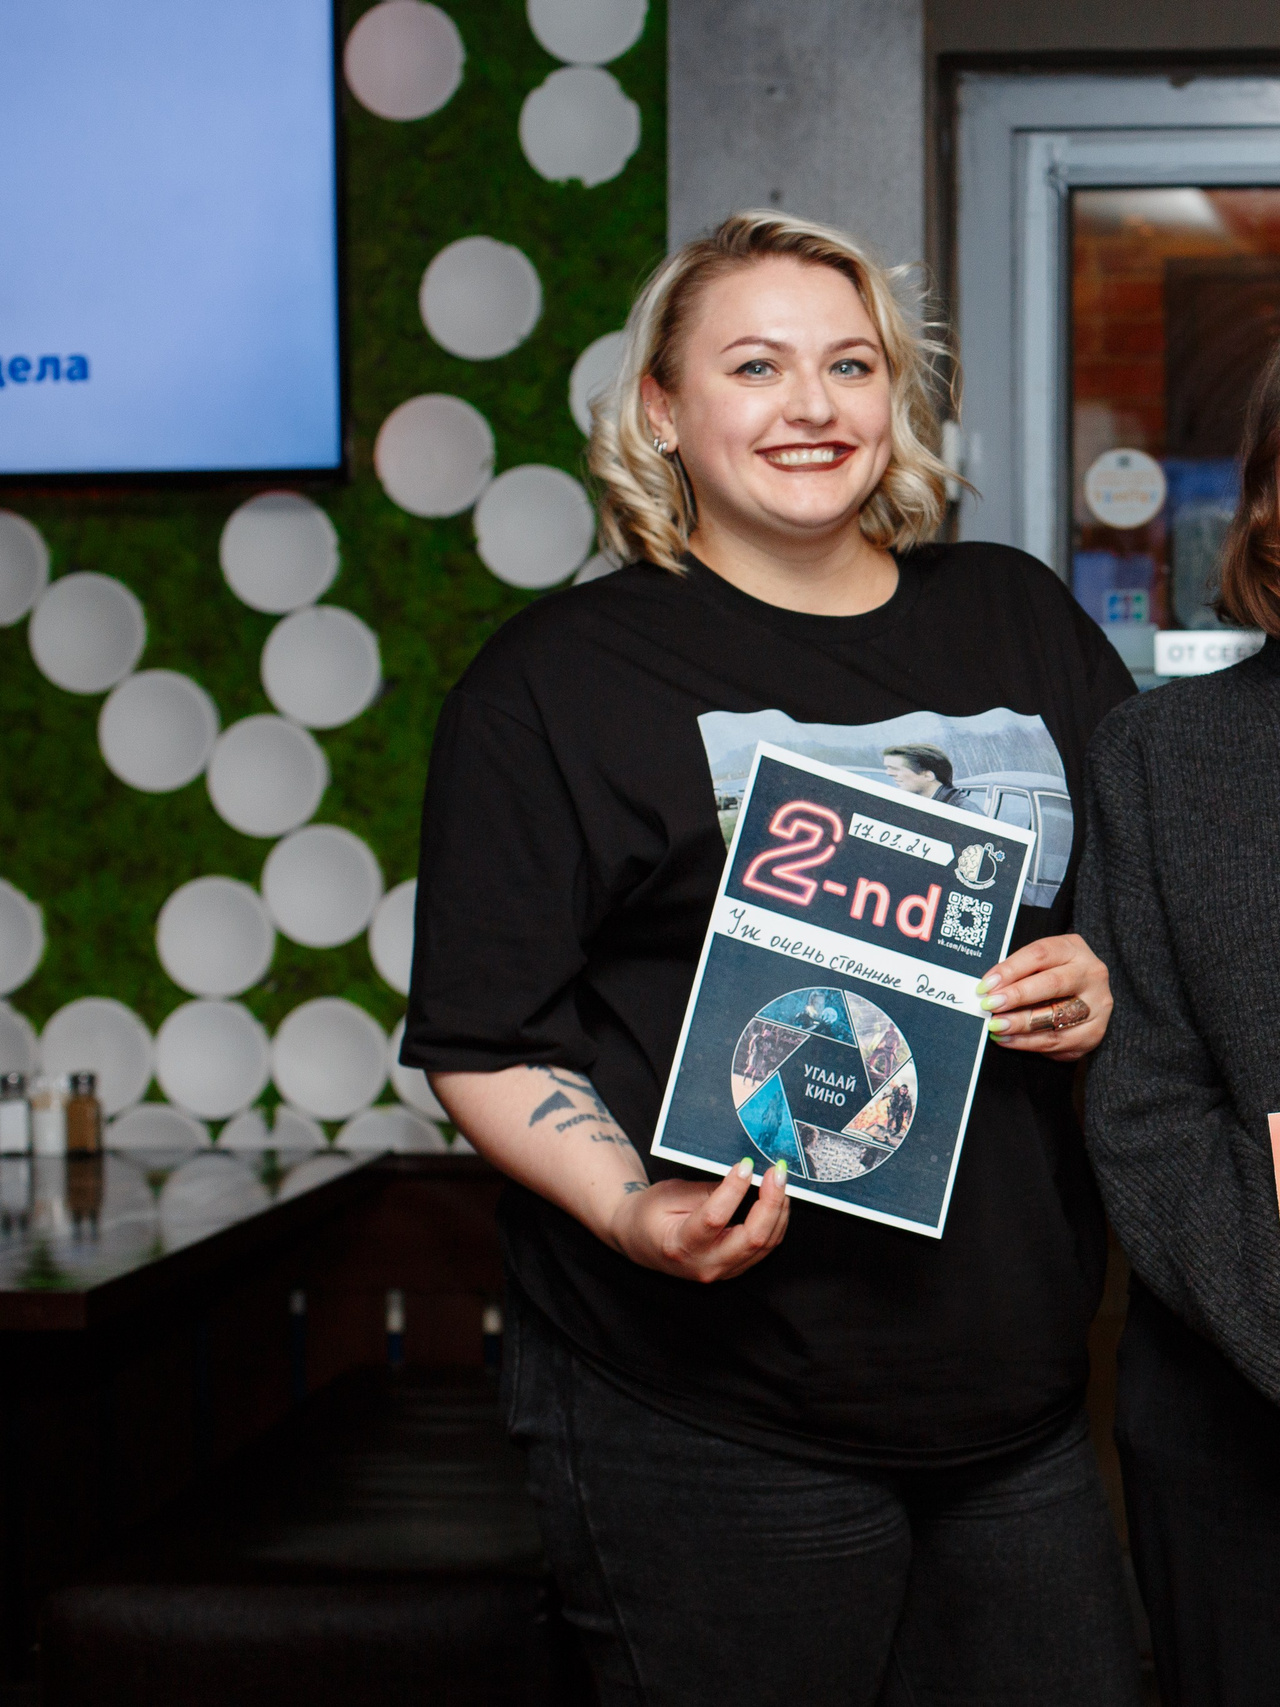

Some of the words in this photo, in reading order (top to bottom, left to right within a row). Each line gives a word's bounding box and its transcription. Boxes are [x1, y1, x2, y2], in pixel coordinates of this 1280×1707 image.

[0, 355, 89, 388] ела
[743, 799, 943, 943] 2-nd
[729, 907, 762, 941] Уж
[770, 935, 825, 964] очень
[916, 973, 964, 1004] дела
[937, 938, 983, 958] vk.com/bigquiz
[803, 1063, 857, 1093] УГАДАЙ
[805, 1082, 846, 1107] КИНО
